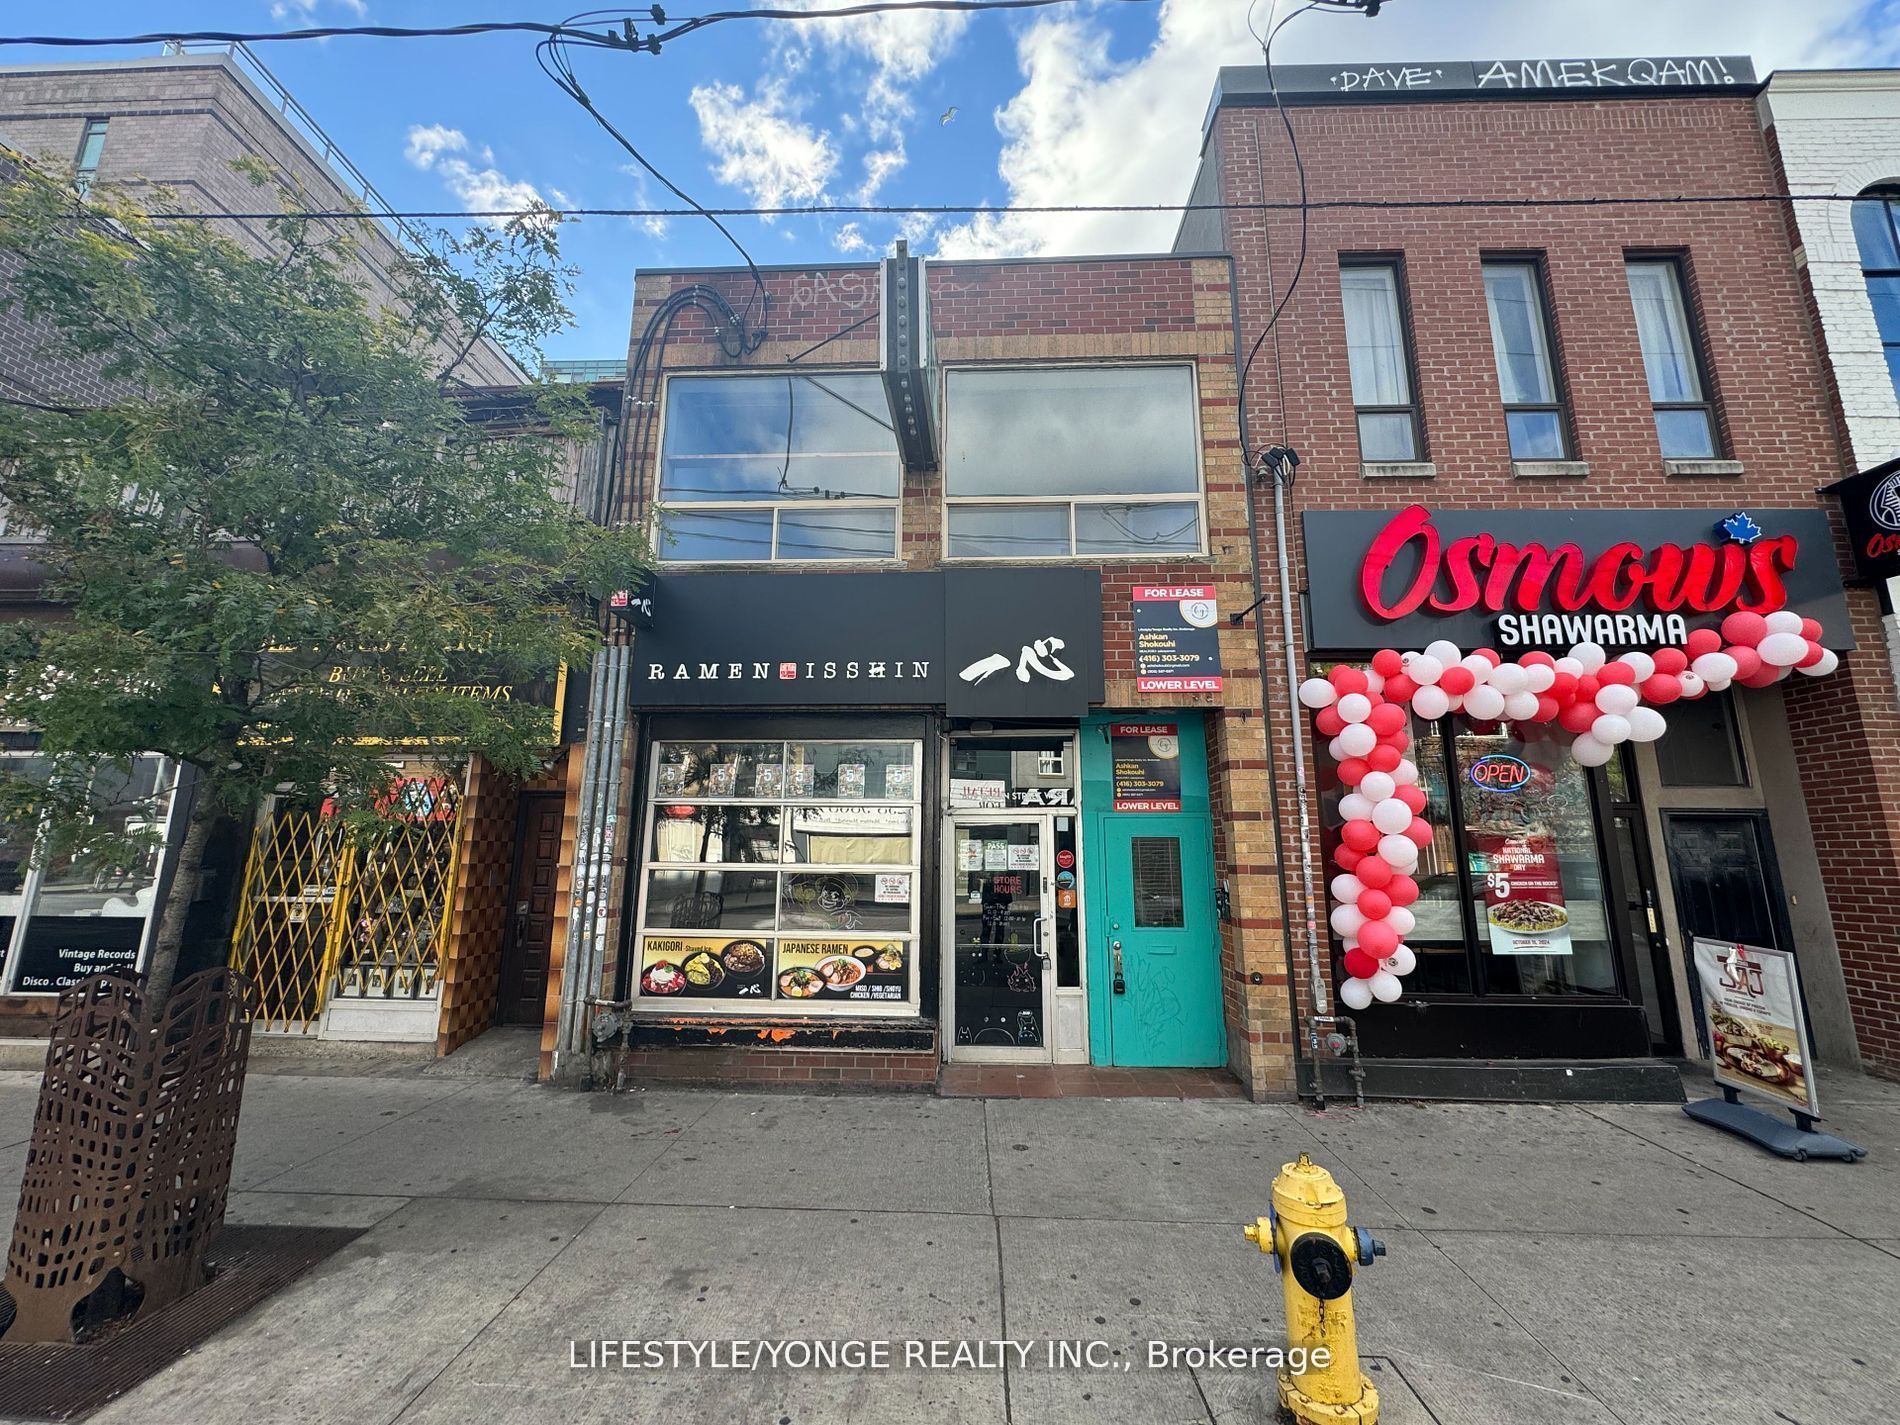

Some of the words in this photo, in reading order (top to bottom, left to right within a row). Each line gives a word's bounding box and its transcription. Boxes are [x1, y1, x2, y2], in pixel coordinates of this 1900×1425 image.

[1144, 589, 1167, 598] FOR
[1169, 588, 1205, 597] LEASE
[1499, 614, 1688, 645] SHAWARMA
[1139, 633, 1168, 641] Ashkan
[1139, 654, 1160, 663] (416)
[1161, 654, 1200, 662] 303-3079
[648, 662, 771, 680] RAMEN
[805, 661, 930, 679] ISSHIN
[1141, 681, 1182, 690] LOWER
[1184, 680, 1220, 690] LEVEL
[1120, 726, 1139, 734] FOR
[1140, 726, 1168, 734] LEASE
[1474, 764, 1525, 783] OPEN
[1116, 802, 1149, 810] LOWER
[1150, 802, 1179, 810] LEVEL
[987, 842, 1005, 850] PASS
[1502, 846, 1532, 854] NATIONAL
[1492, 854, 1545, 864] SHAWARMA
[1513, 863, 1526, 871] DAY
[993, 876, 1021, 885] STORE
[647, 941, 683, 952] KAKIGORI
[782, 943, 820, 954] JAPANESE
[821, 943, 849, 954] RAMEN
[59, 949, 95, 960] Vintage
[97, 950, 136, 960] Records
[74, 963, 92, 974] Buy
[22, 977, 48, 986] Disco
